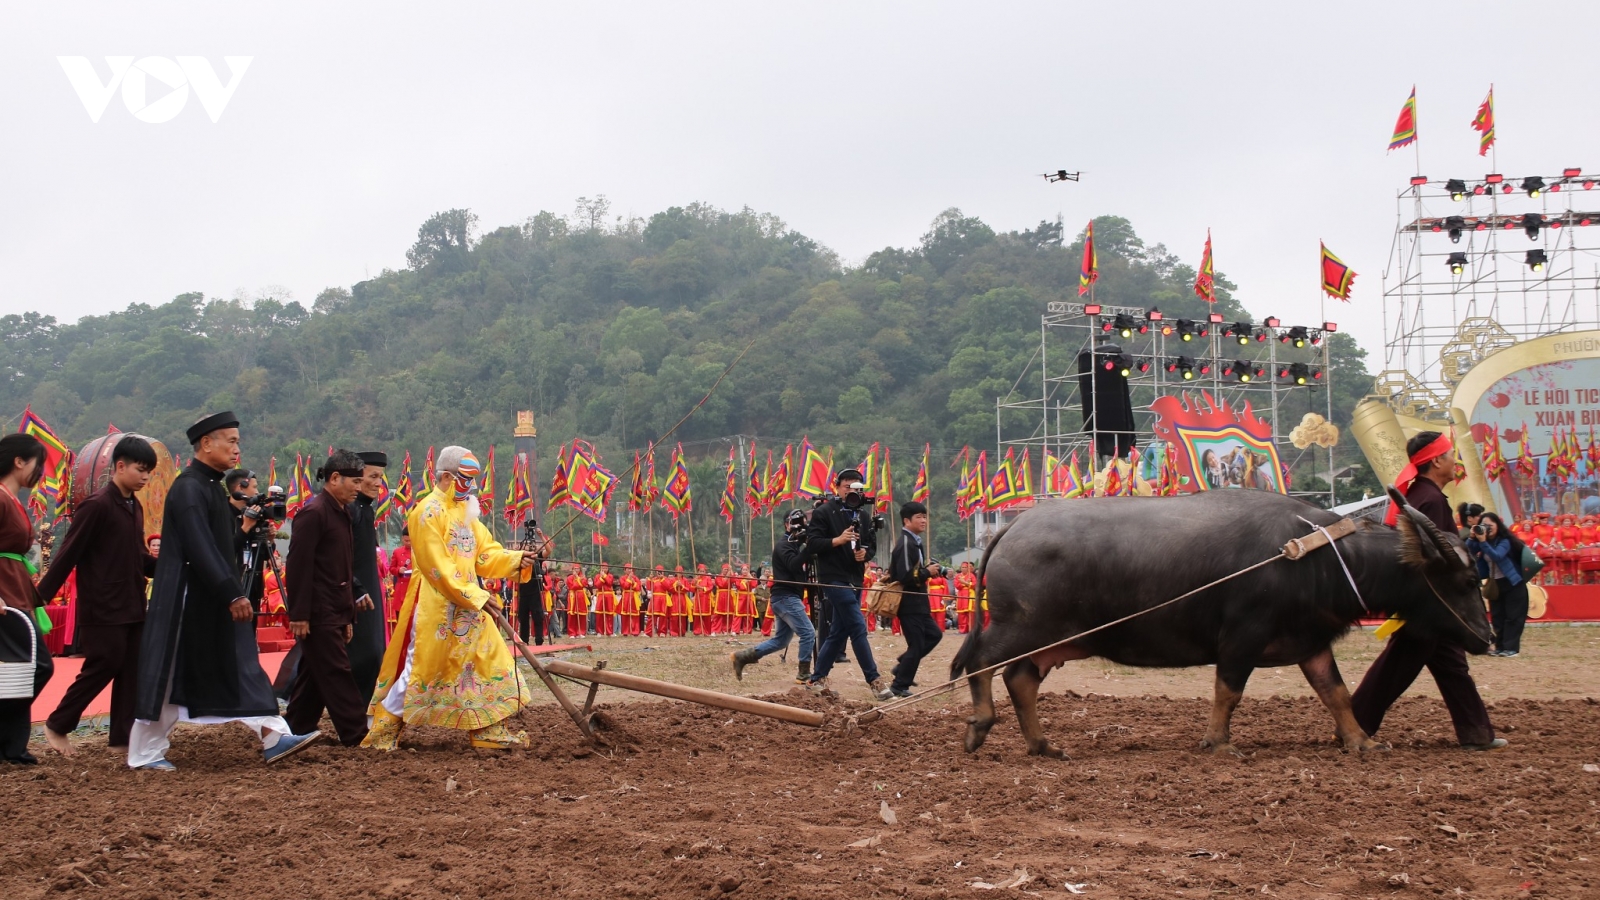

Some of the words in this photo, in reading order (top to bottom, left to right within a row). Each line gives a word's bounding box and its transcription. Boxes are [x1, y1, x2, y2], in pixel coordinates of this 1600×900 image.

[1545, 387, 1569, 407] HỘI
[1574, 388, 1600, 406] TỊC
[1535, 408, 1575, 426] XUÂN
